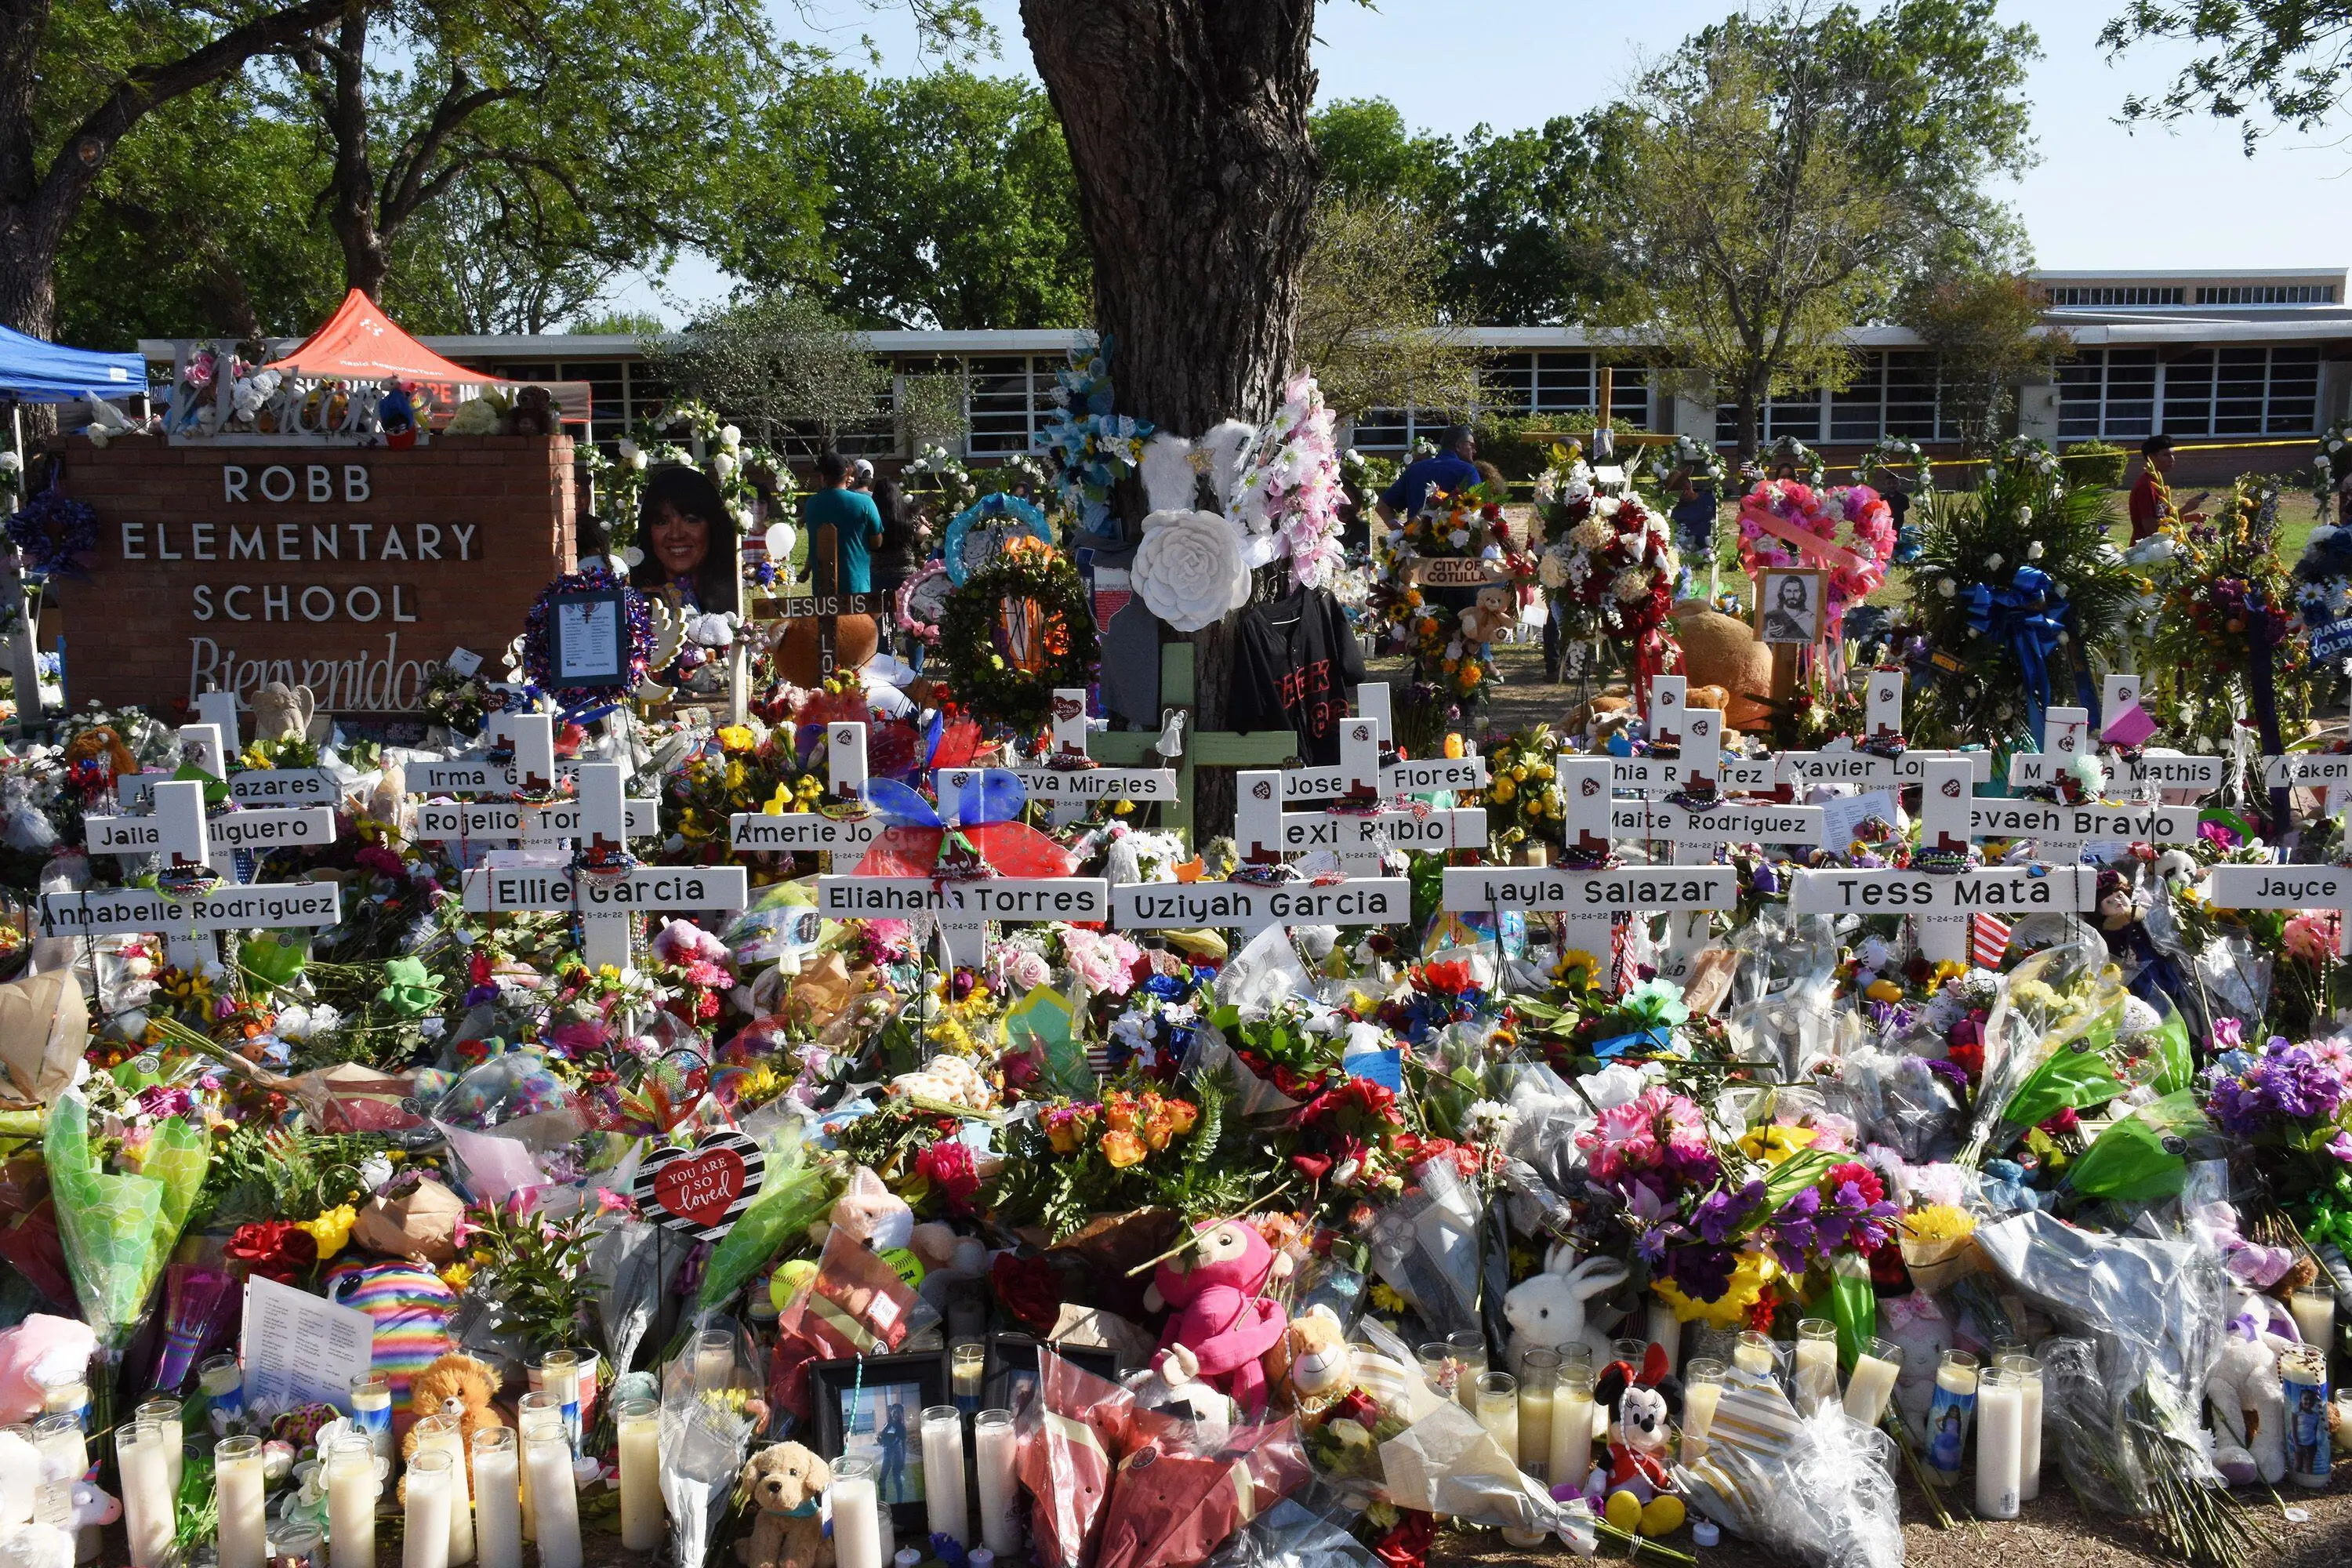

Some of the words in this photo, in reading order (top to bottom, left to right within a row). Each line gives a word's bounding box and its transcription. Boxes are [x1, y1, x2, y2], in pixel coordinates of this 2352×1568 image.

[223, 465, 370, 503] ROBB
[121, 523, 476, 562] ELEMENTARY
[1427, 572, 1488, 583] COTULLA
[1433, 560, 1462, 572] CITY
[1465, 560, 1482, 572] OF
[193, 586, 416, 623] SCHOOL
[779, 596, 838, 618] JESUS
[850, 594, 866, 614] IS
[429, 768, 486, 786] Irma
[504, 765, 579, 784] Gcia
[1286, 775, 1342, 796] Jose
[1394, 764, 1477, 788] Flores
[1792, 758, 1877, 778] Xavier
[2129, 763, 2212, 782] Mathis
[2281, 763, 2348, 780] Maken
[233, 777, 321, 797] azares
[1018, 774, 1059, 791] Eva
[1069, 775, 1157, 793] Mireles
[100, 826, 159, 846] Jaila
[207, 820, 308, 845] ilguero
[425, 811, 519, 837] Rojelio
[539, 810, 635, 829] Tors
[735, 822, 837, 844] Amerie
[844, 823, 873, 843] Jo
[1286, 821, 1338, 845] exi
[1359, 819, 1443, 841] Rubio
[1688, 814, 1806, 835] Rodriguez
[1970, 809, 2060, 832] evaeh
[2074, 812, 2174, 837] Bravo
[498, 878, 571, 904] Ellie
[589, 877, 706, 904] Garcia
[829, 887, 964, 910] Eliahana
[975, 888, 1095, 912] Torres
[1484, 880, 1564, 906] Layla
[1584, 879, 1719, 904] Salazar
[1837, 880, 1933, 906] Tess
[1954, 878, 2051, 906] Mata
[2256, 877, 2337, 901] Jayce
[39, 901, 183, 928] Annabelle
[193, 895, 335, 922] Rodriguez
[1134, 892, 1252, 924] Uziyah
[1269, 891, 1388, 918] Garcia
[170, 933, 209, 942] 5-24-22
[1612, 953, 1623, 992] SUBARU
[668, 1167, 696, 1185] YOU
[701, 1156, 728, 1174] ARE
[694, 1176, 713, 1190] SO
[675, 1170, 732, 1210] loved
